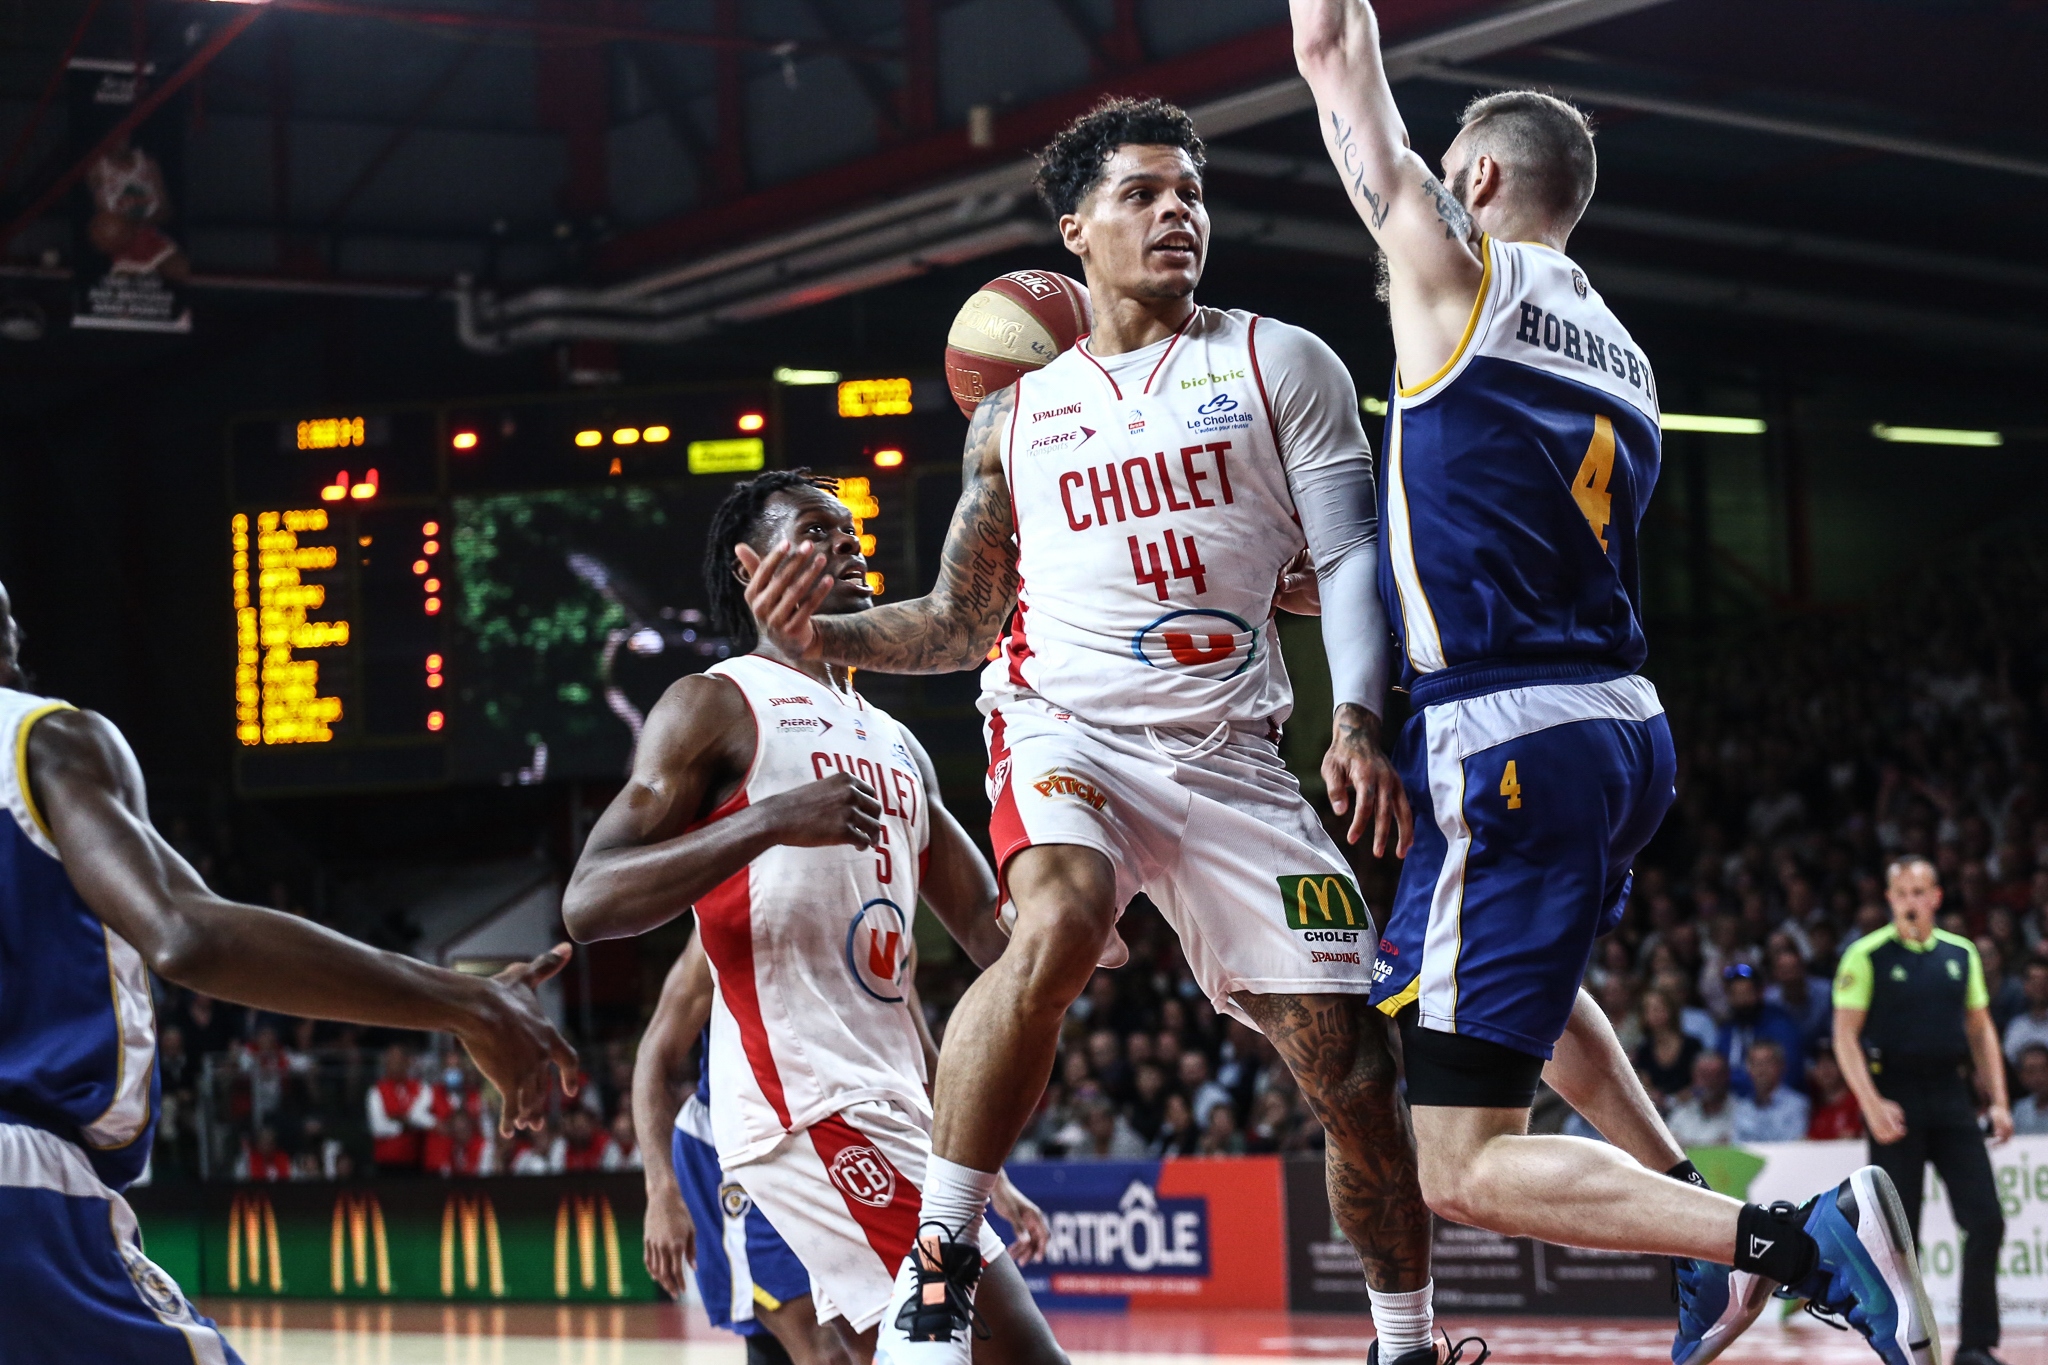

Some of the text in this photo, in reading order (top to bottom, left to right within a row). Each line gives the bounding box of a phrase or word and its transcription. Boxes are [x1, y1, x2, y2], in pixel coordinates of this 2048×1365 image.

[1515, 301, 1655, 400] HORNSBY
[1032, 402, 1081, 424] SPALDING
[1187, 412, 1253, 429] Le Choletais
[1026, 442, 1069, 457] Transports
[1031, 431, 1077, 449] PIERRE
[1059, 441, 1233, 531] CHOLET
[1571, 414, 1616, 554] 4
[1127, 529, 1207, 601] 44
[768, 696, 814, 707] SPALDING
[1500, 760, 1521, 809] 4
[1304, 932, 1359, 943] CHOLET
[1311, 951, 1360, 965] SPALDING
[1373, 958, 1393, 975] kka
[841, 1157, 888, 1198] CB
